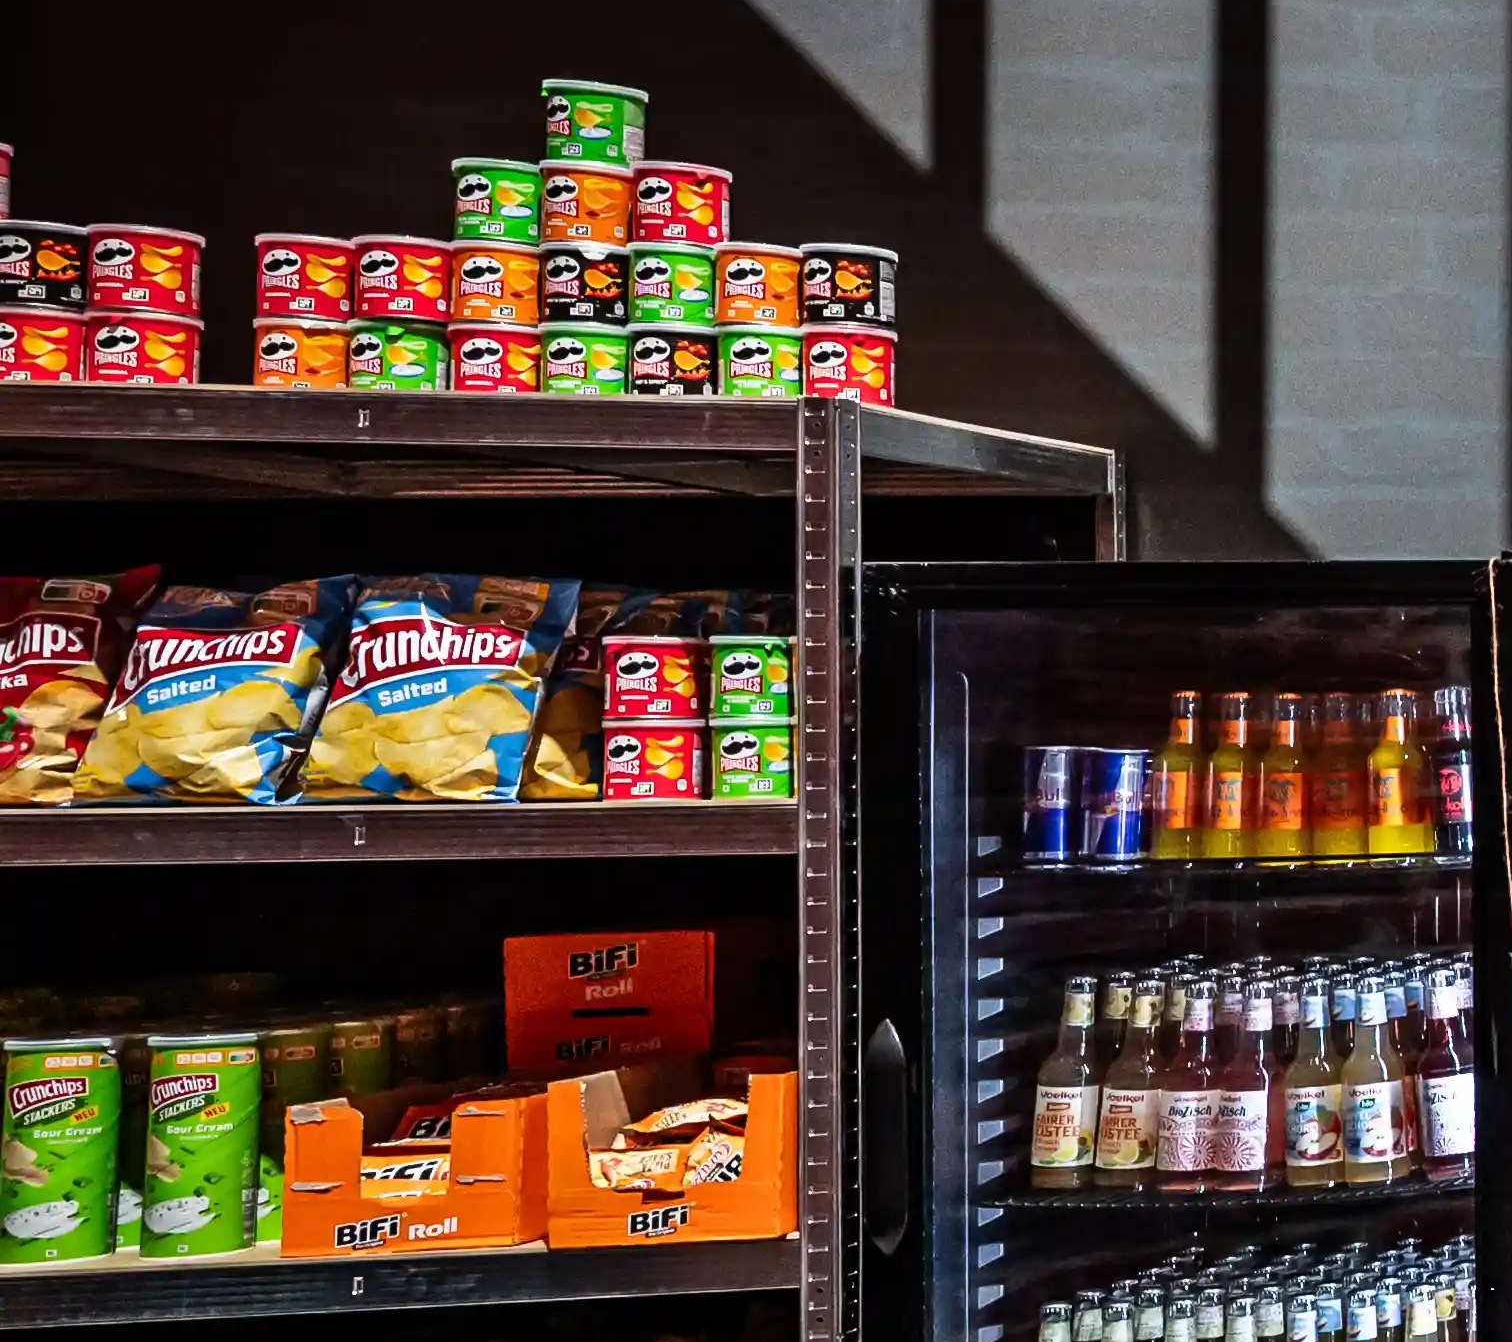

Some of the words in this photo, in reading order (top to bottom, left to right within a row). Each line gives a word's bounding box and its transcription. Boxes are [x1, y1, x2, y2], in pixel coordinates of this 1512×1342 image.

[461, 281, 502, 296] PRINGLES
[461, 362, 501, 378] PRINGLES
[146, 675, 216, 705] Salted
[379, 677, 447, 715] Salted
[616, 677, 657, 693] PRINGLES
[585, 980, 634, 1001] Roll
[12, 1078, 83, 1110] Crunchips
[152, 1076, 213, 1104] Crunchips
[23, 1098, 76, 1125] STACKERS
[73, 1108, 96, 1122] NEU
[159, 1095, 205, 1121] STACKERS
[204, 1104, 226, 1118] NEU
[1168, 1106, 1212, 1116] BioZisch
[336, 1216, 399, 1247] BiFi
[409, 1217, 457, 1240] Roll
[630, 1205, 690, 1234] BiFi
